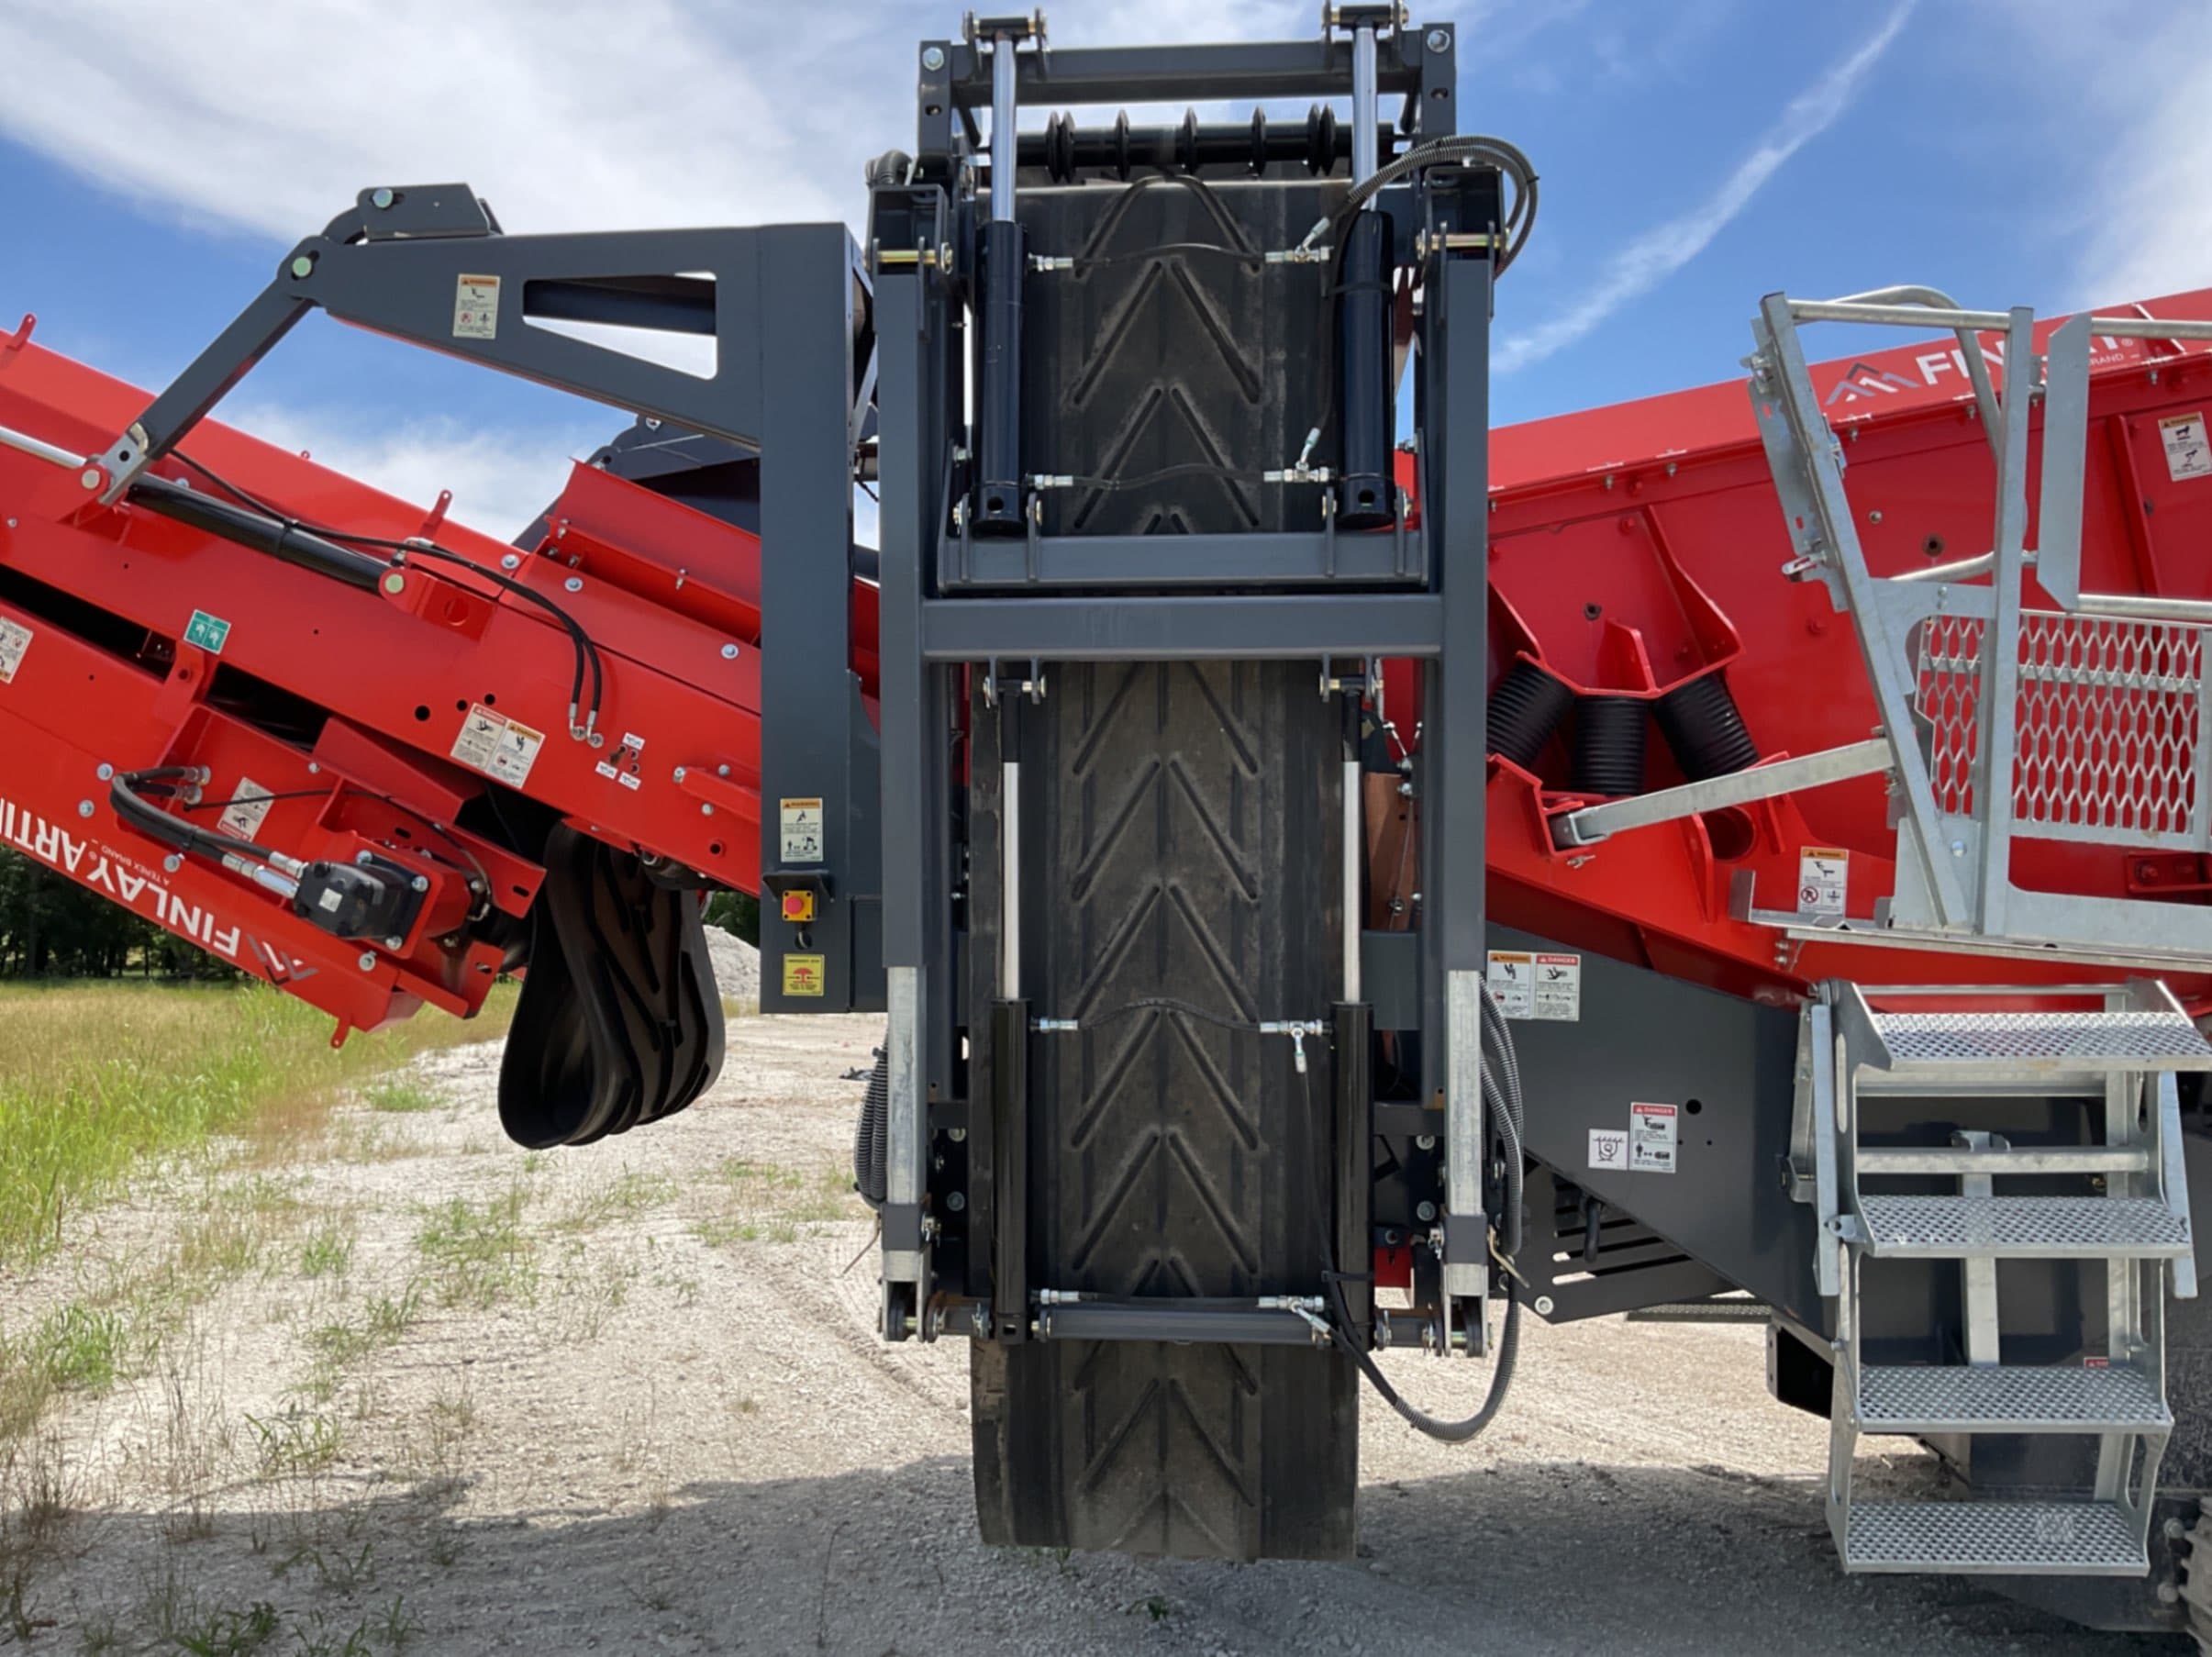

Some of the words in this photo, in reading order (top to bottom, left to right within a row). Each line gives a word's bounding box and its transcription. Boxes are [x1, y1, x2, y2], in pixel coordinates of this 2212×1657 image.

[2089, 352, 2125, 366] RAND
[101, 844, 132, 867] BRAND
[133, 862, 161, 884] TEREX
[86, 855, 241, 958] FINLAY
